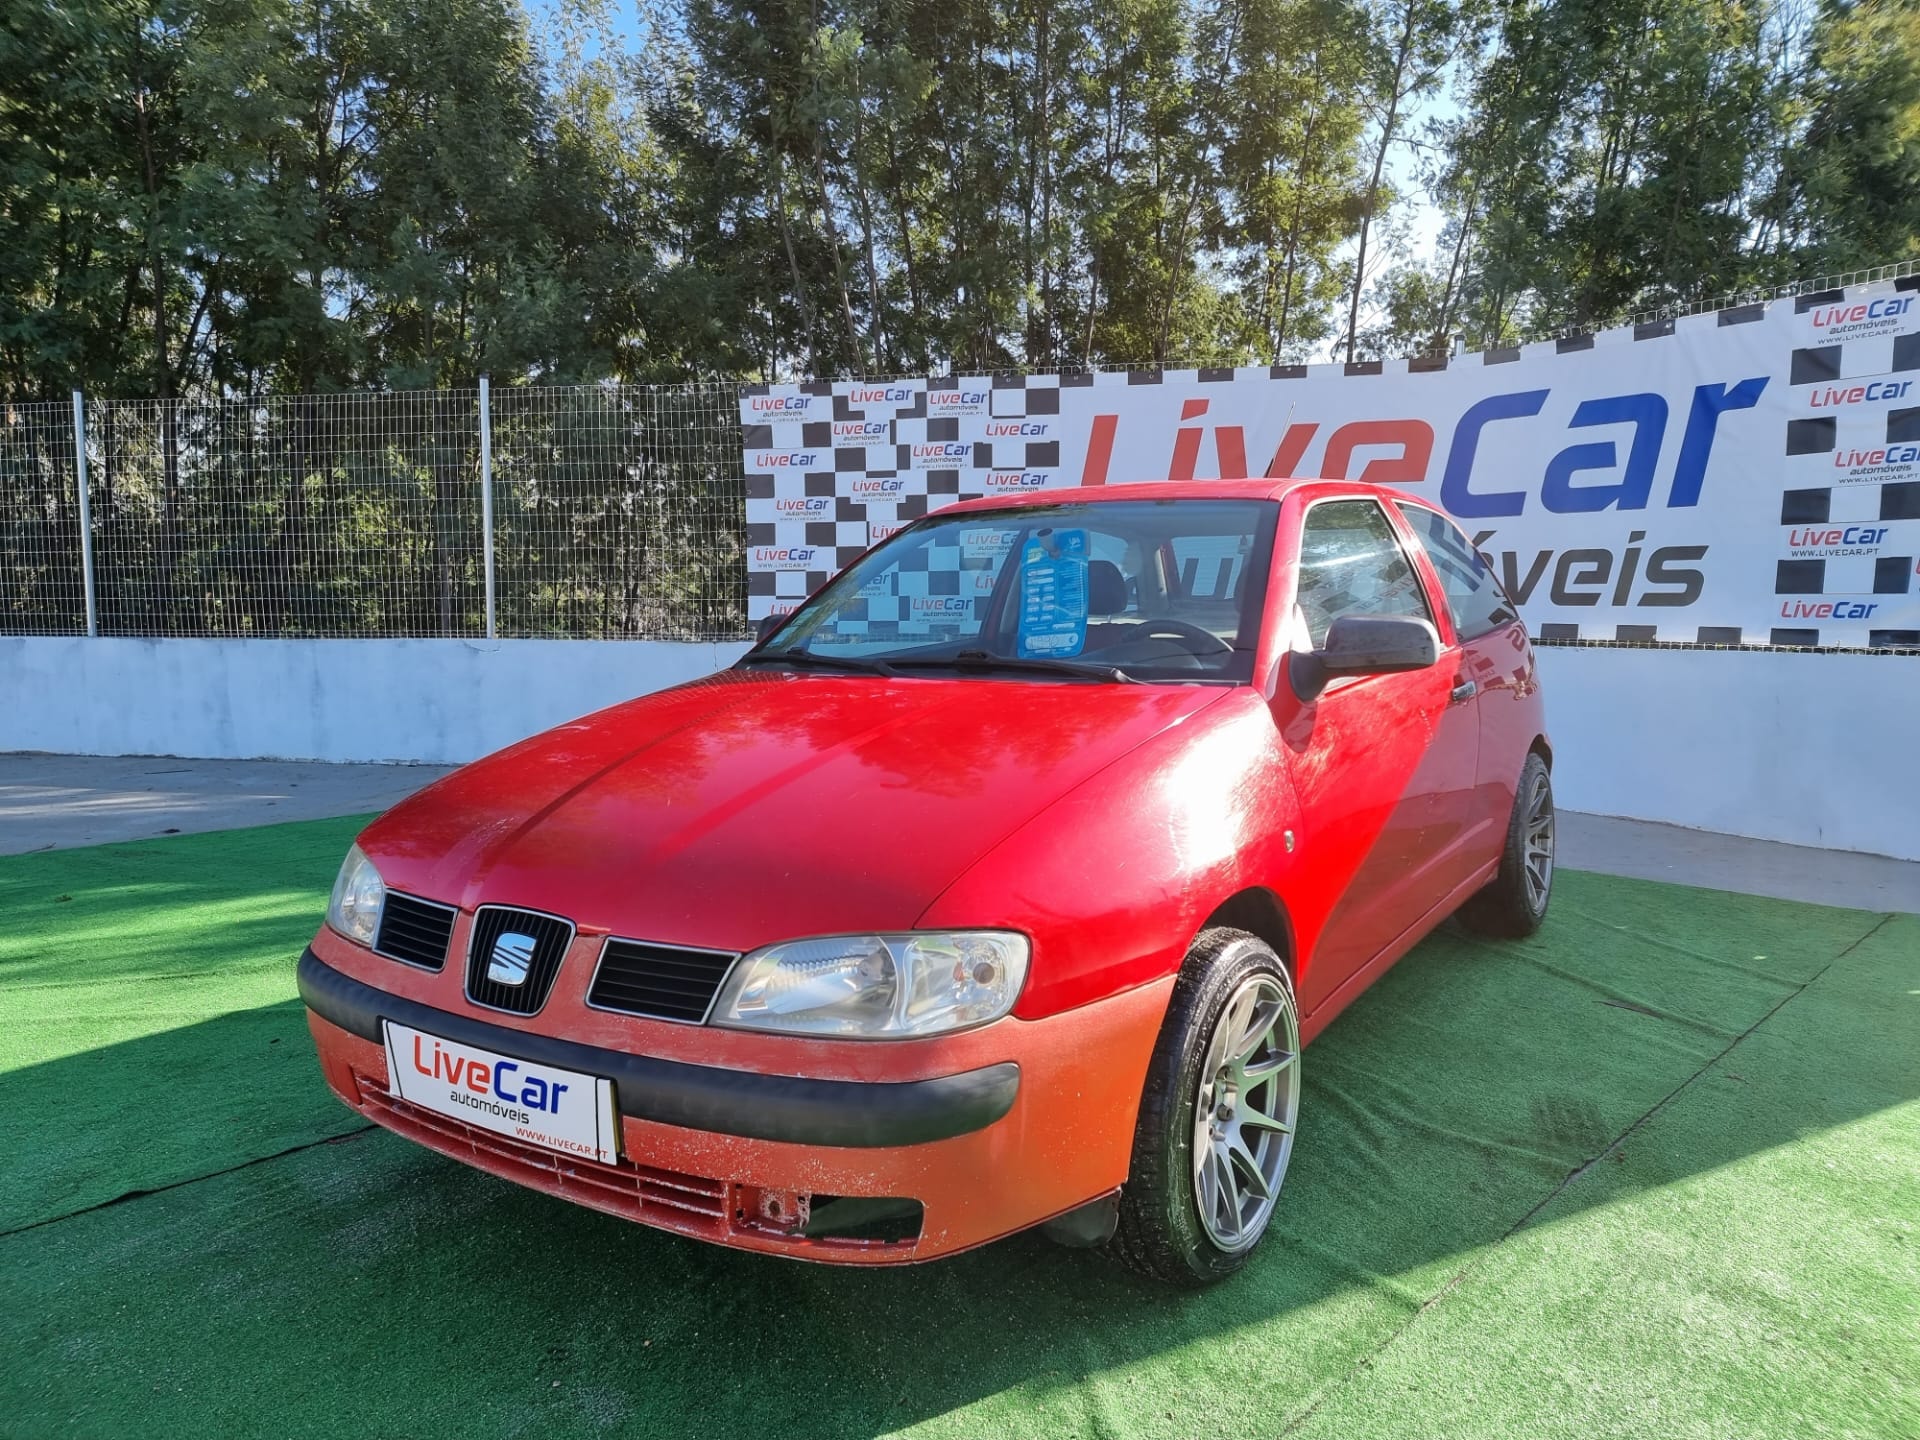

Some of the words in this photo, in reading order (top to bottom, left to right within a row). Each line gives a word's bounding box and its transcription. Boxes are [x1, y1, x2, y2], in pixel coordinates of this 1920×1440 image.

[1813, 297, 1915, 328] LiveCar
[1829, 317, 1898, 335] automóveis
[1818, 327, 1905, 345] WWW.LIVECAR.PT
[851, 388, 912, 403] LiveCar
[930, 392, 987, 405] LiveCar
[1810, 381, 1913, 408] LiveCar
[752, 397, 811, 410] LiveCar
[833, 423, 888, 435] LiveCar
[985, 423, 1048, 436] LiveCar
[913, 443, 971, 457] LiveCar
[1082, 376, 1770, 518] LiveCar
[756, 453, 816, 467] LiveCar
[1835, 446, 1920, 468] LiveCa
[1850, 463, 1912, 475] automóveis
[852, 480, 904, 492] LiveCar
[986, 473, 1048, 485] LiveCar
[776, 499, 829, 511] LiveCar
[1789, 527, 1889, 547] LiveCar
[756, 548, 815, 561] LiveCar
[1791, 547, 1880, 557] WWW.LIVECAR.PT
[912, 598, 973, 611] LiveCar
[1781, 600, 1878, 619] LiveCar
[414, 1035, 569, 1114] LiveCar
[450, 1090, 530, 1125] automóveis
[515, 1126, 609, 1160] WWW.LIVECAR.PT
